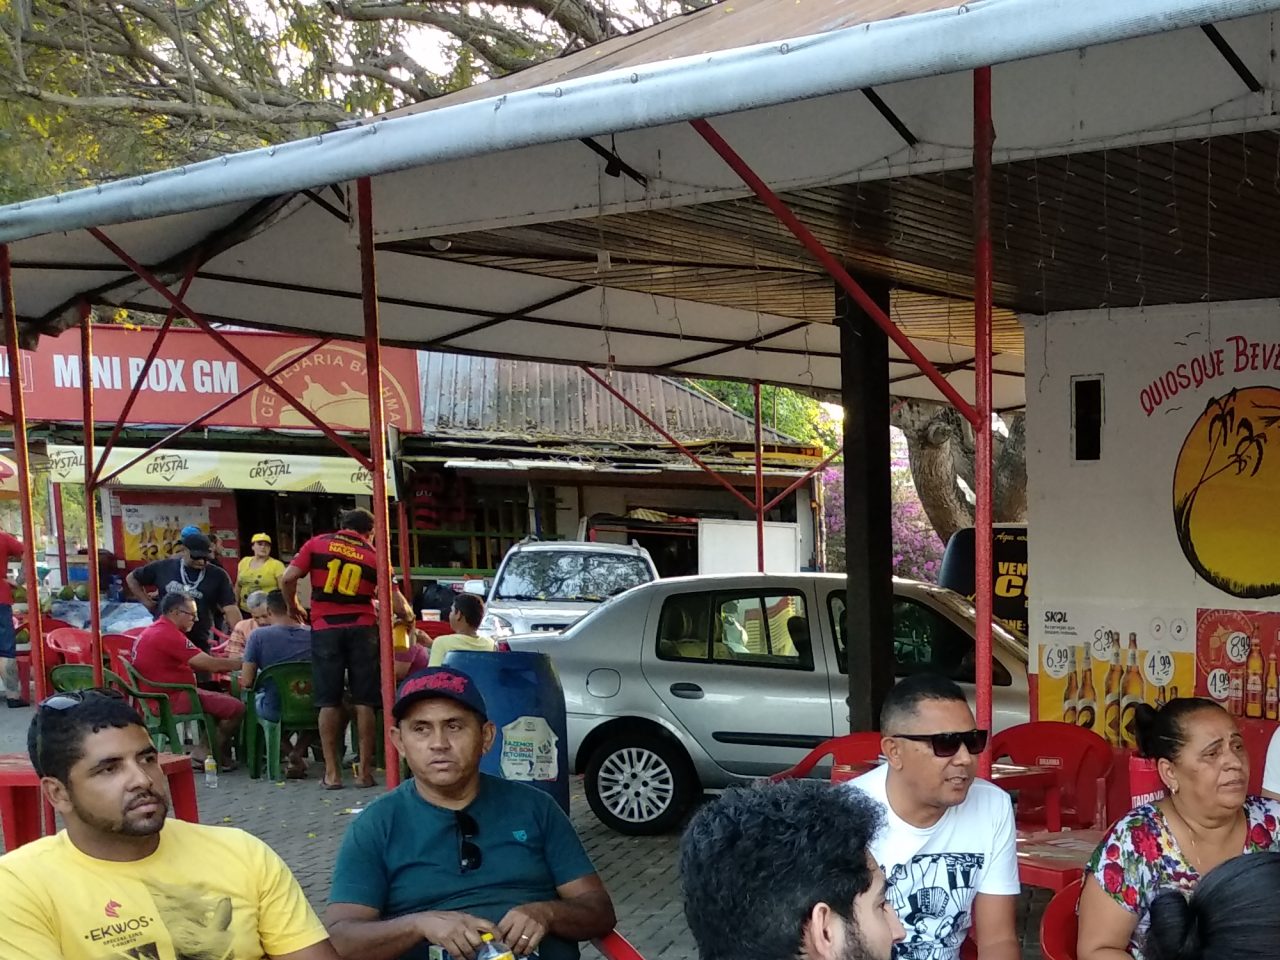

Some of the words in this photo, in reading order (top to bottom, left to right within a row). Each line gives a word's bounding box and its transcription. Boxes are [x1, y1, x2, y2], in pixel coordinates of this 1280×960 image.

[53, 354, 123, 390] MNI
[128, 357, 187, 392] BOX
[192, 360, 239, 394] GM
[1139, 348, 1225, 417] QUIOSQUE
[351, 362, 401, 422] BHMA
[146, 458, 189, 475] CRYSTAL
[249, 463, 292, 479] CRYSTAL
[350, 469, 391, 483] CRYSL
[323, 558, 363, 597] 10
[994, 574, 1028, 598] C
[1044, 611, 1068, 623] SKOL
[1131, 790, 1165, 809] ITAIPAVA
[90, 916, 150, 942] EKWOS
